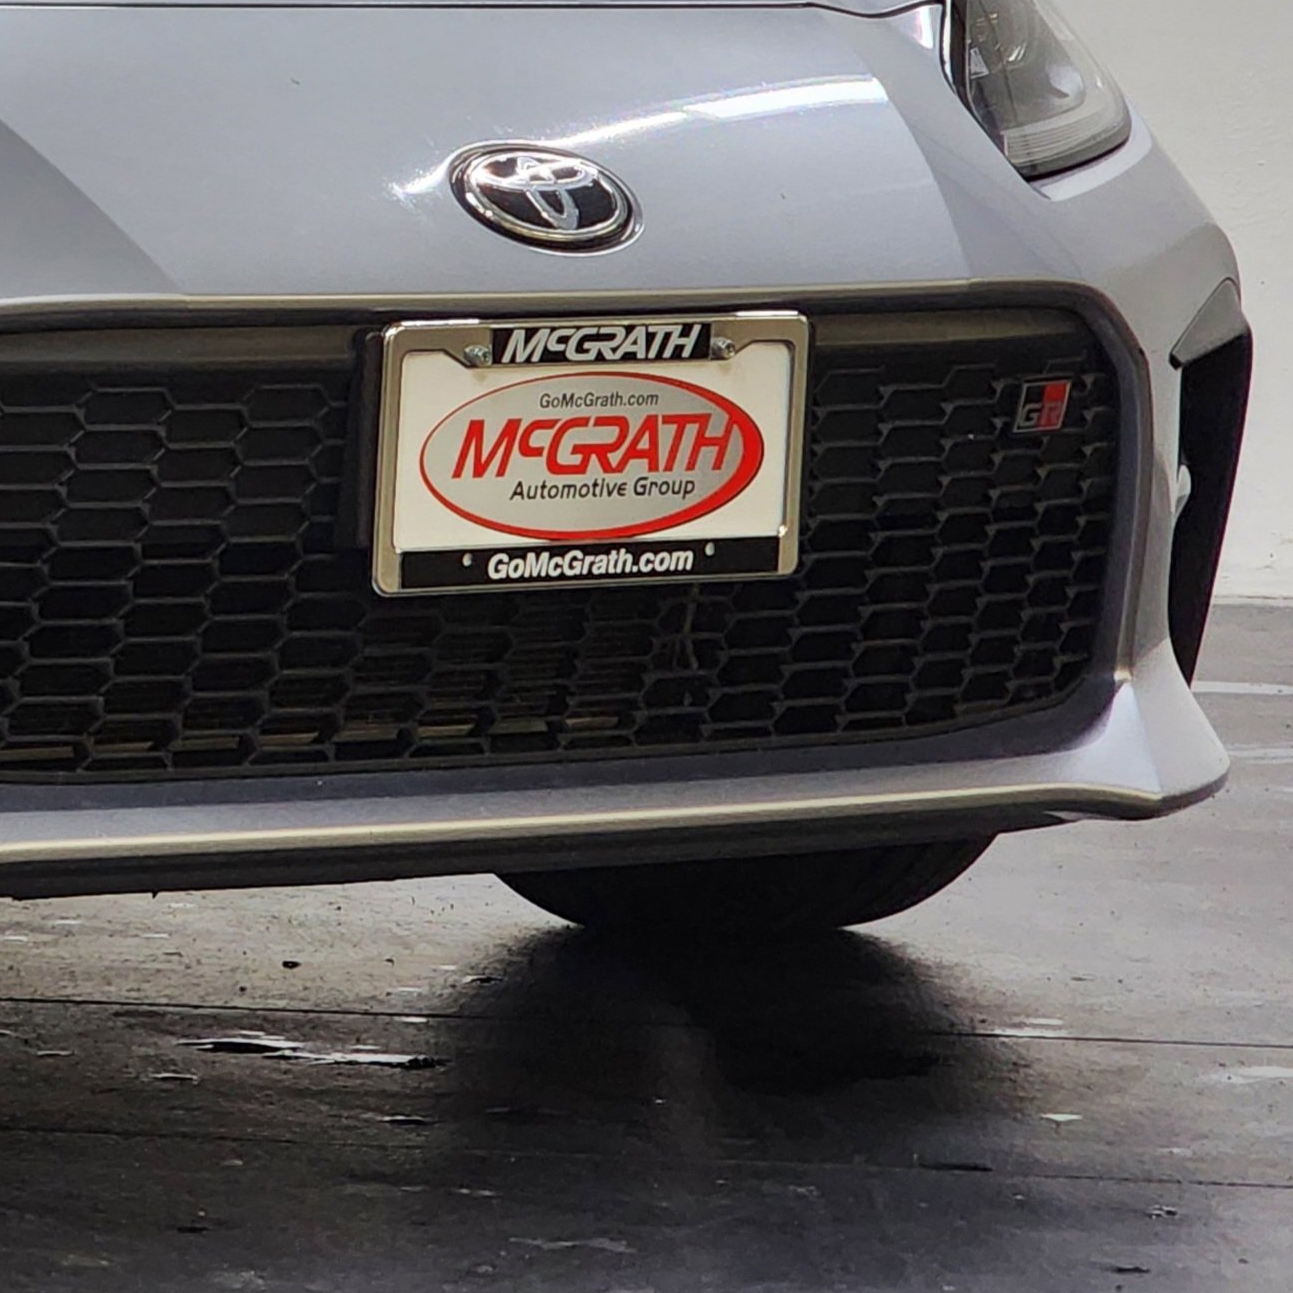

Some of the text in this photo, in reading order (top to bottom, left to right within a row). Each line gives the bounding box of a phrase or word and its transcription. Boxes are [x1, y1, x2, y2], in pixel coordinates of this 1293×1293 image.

[539, 392, 659, 408] GoMcGrath.com
[509, 476, 696, 501] Automotive Group
[487, 548, 694, 580] GoMcGrath.com
